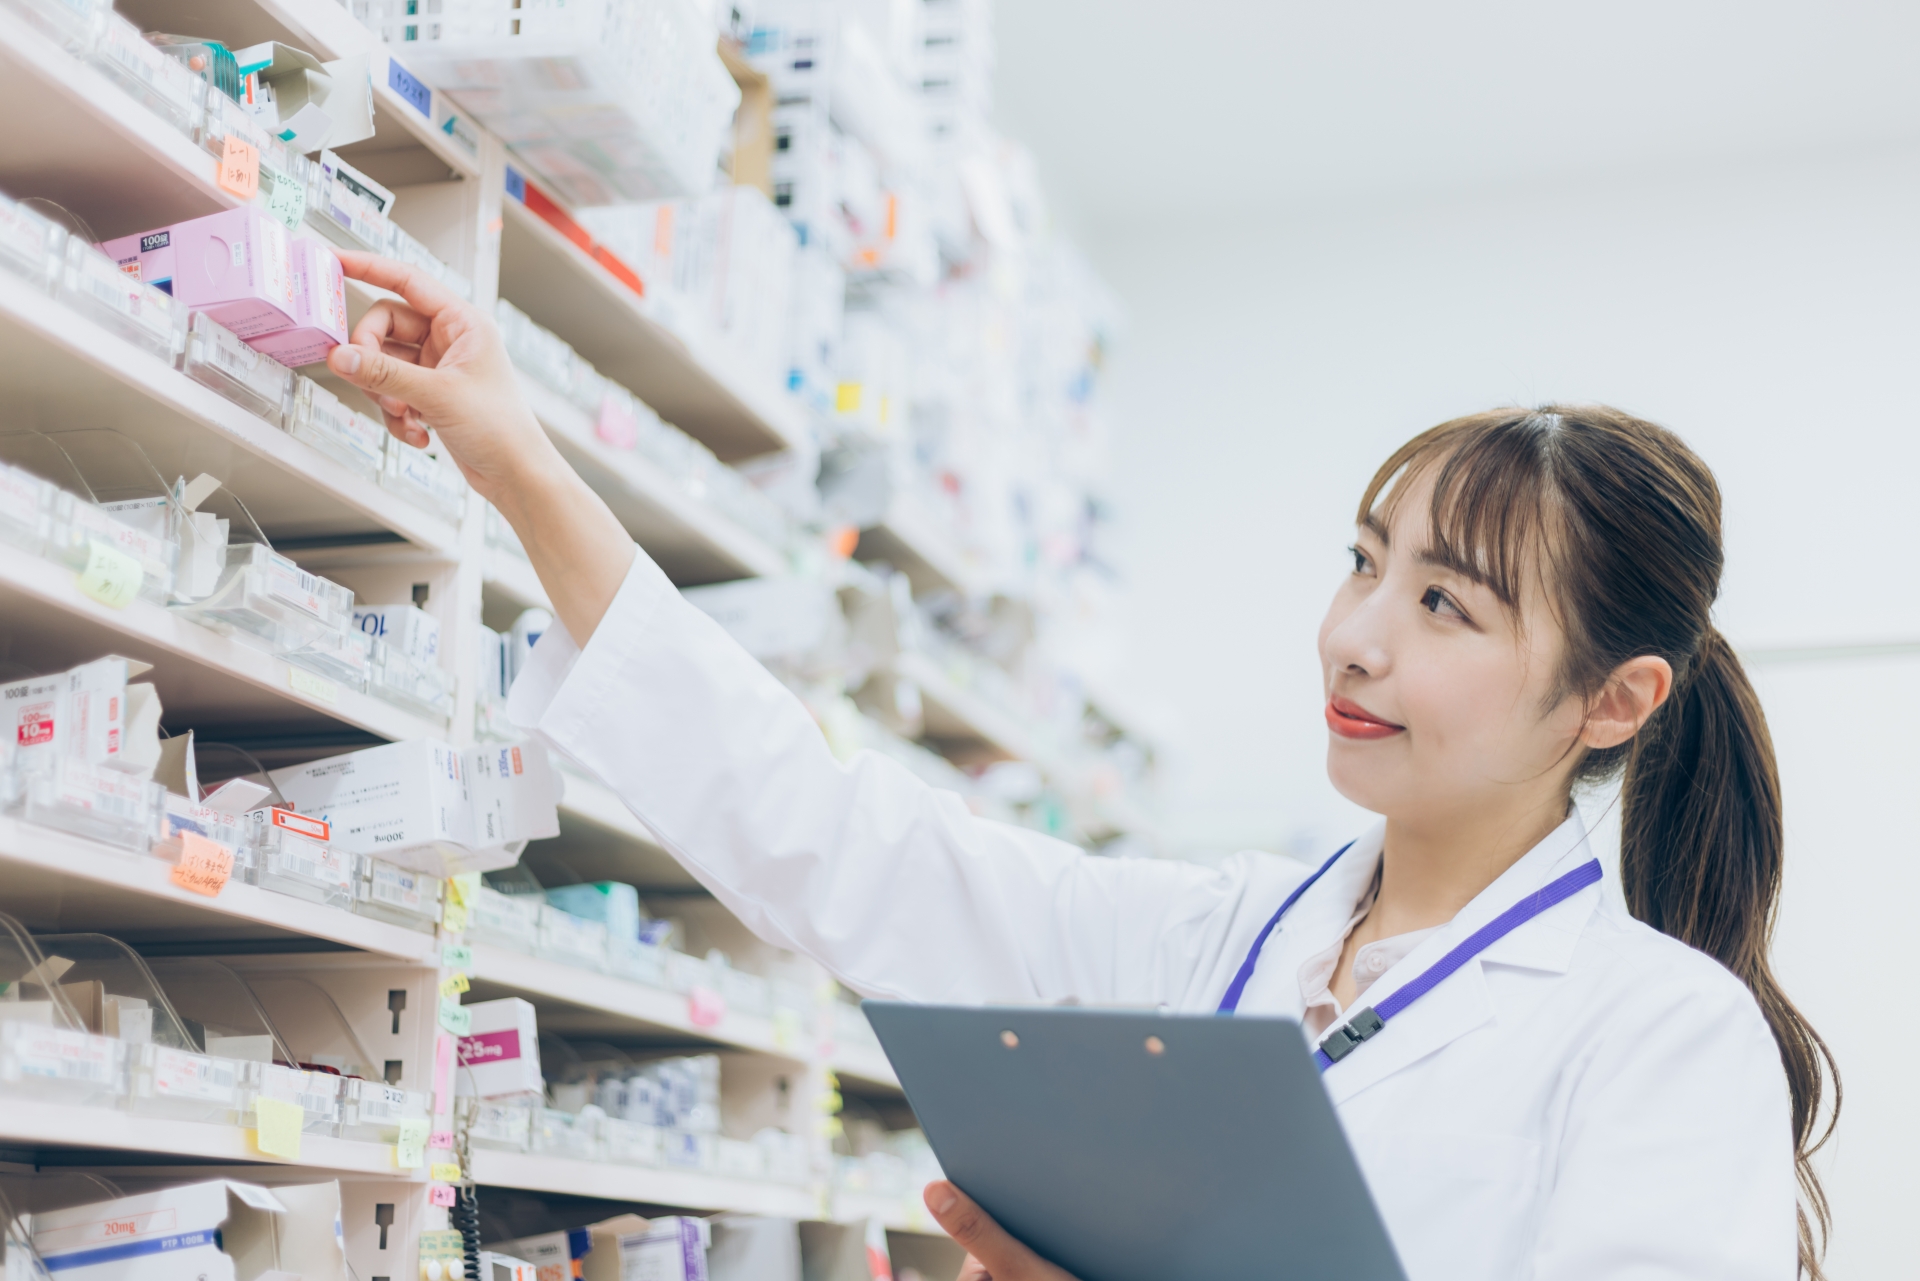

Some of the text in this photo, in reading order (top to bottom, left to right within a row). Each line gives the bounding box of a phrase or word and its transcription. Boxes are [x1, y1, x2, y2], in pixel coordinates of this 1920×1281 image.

[22, 712, 50, 723] 100mg
[22, 723, 51, 739] 10mg
[104, 1221, 136, 1236] 20mg
[161, 1238, 178, 1250] PTP
